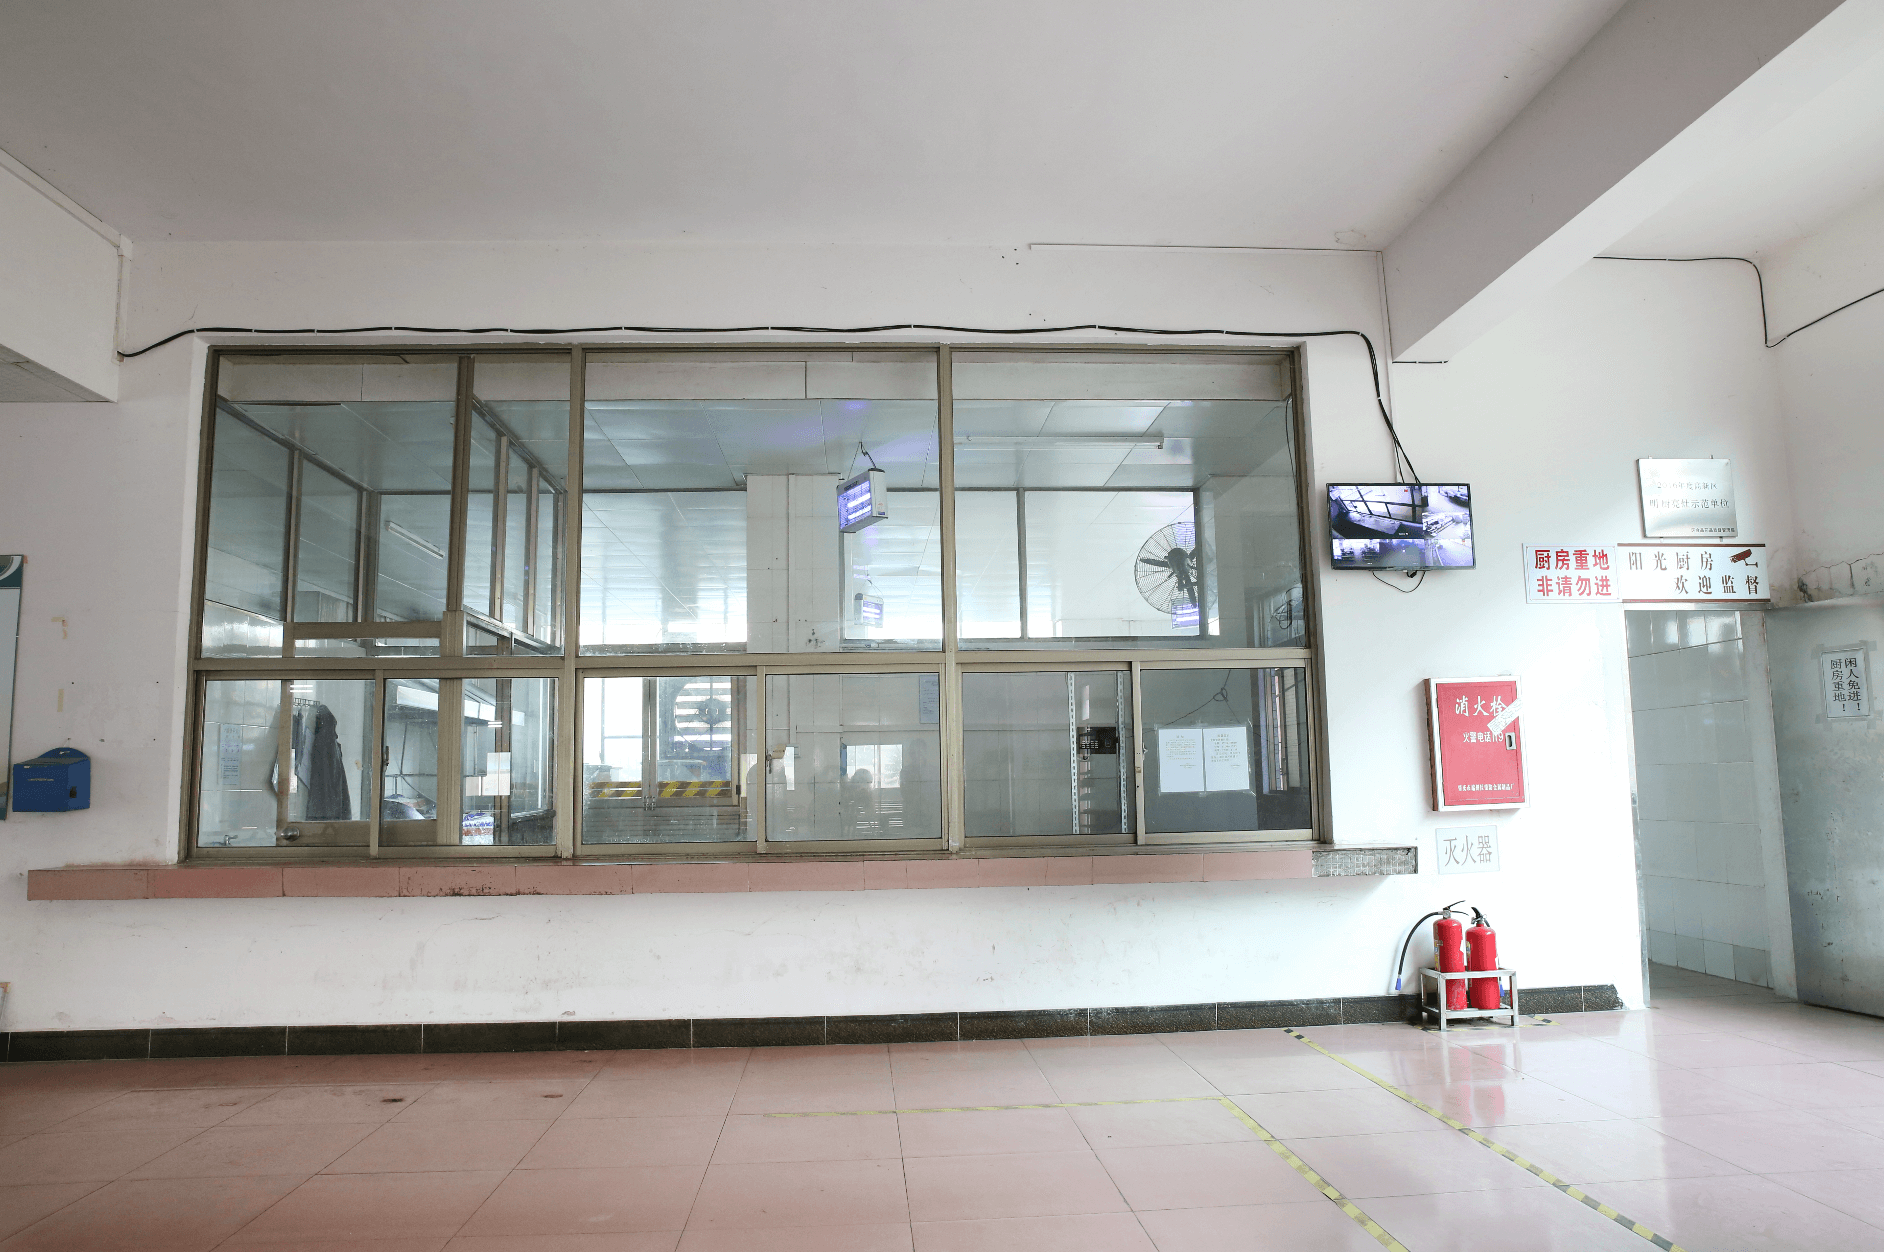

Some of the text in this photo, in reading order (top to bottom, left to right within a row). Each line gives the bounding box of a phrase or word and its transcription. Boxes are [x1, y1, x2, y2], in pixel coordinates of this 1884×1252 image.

[1534, 549, 1610, 571] 厨房重地
[1628, 550, 1714, 572] 阳光厨房
[1536, 575, 1612, 597] 非请勿进
[1674, 574, 1759, 596] 欢迎监督
[1455, 695, 1508, 717] 消火栓
[1442, 834, 1493, 868] 灭火器
